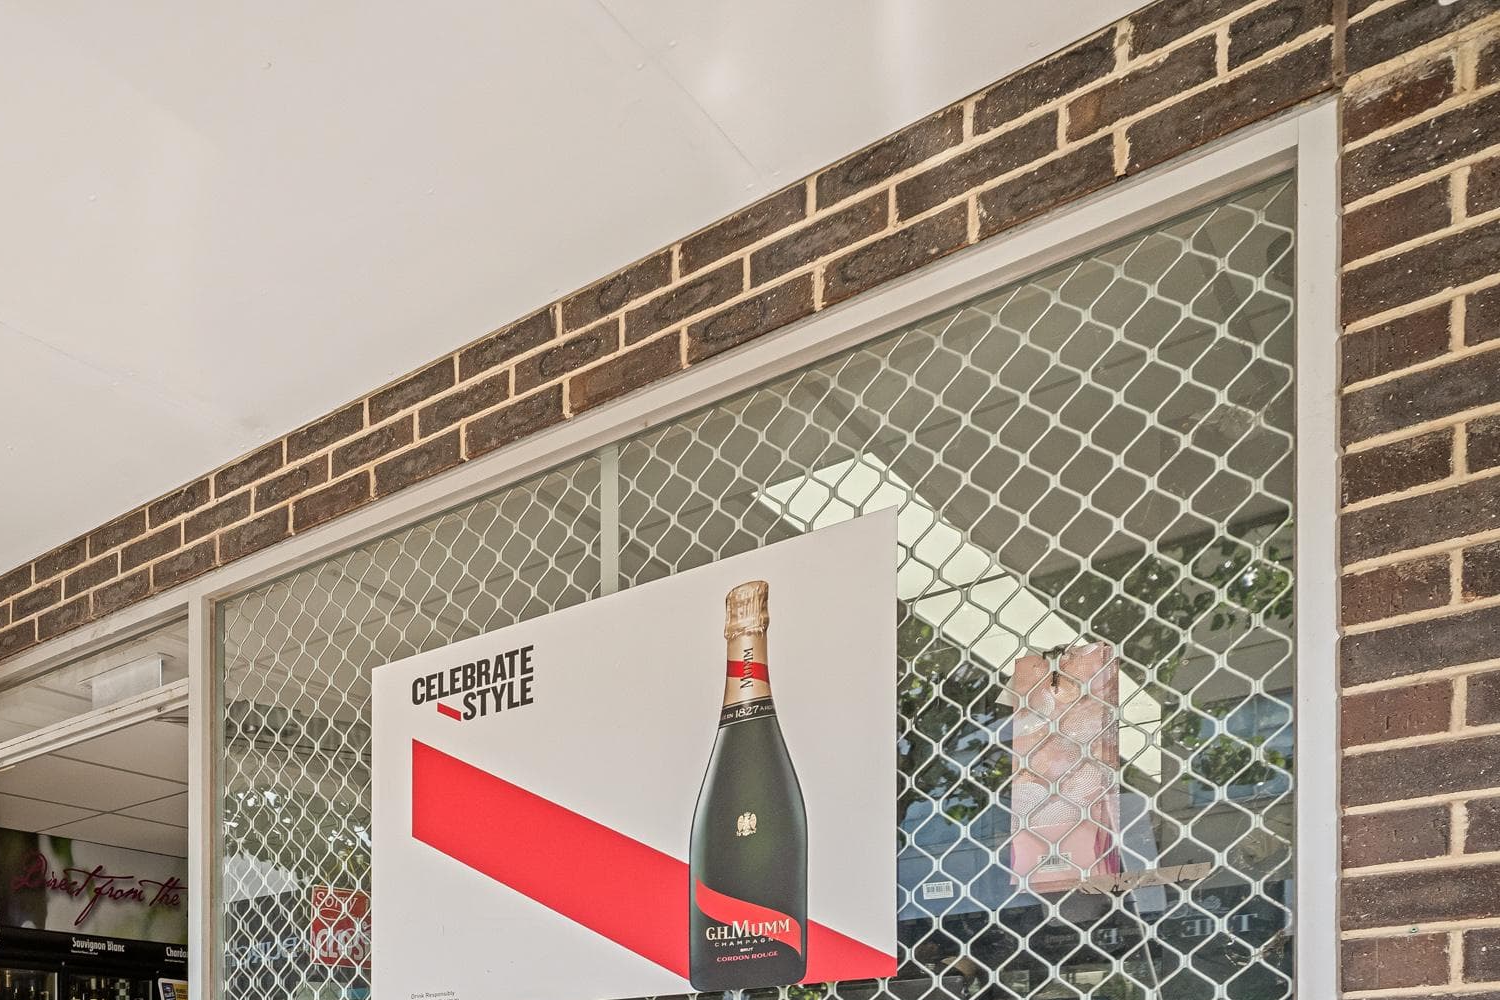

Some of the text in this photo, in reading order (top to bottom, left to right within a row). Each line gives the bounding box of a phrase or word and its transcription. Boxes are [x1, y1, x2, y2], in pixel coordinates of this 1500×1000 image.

[412, 645, 534, 705] CELEBRATE
[463, 676, 534, 720] STYLE
[735, 705, 759, 718] 1827
[74, 878, 146, 926] from
[72, 936, 125, 952] Sauvignon Blanc
[716, 950, 779, 963] CORDON ROUGE
